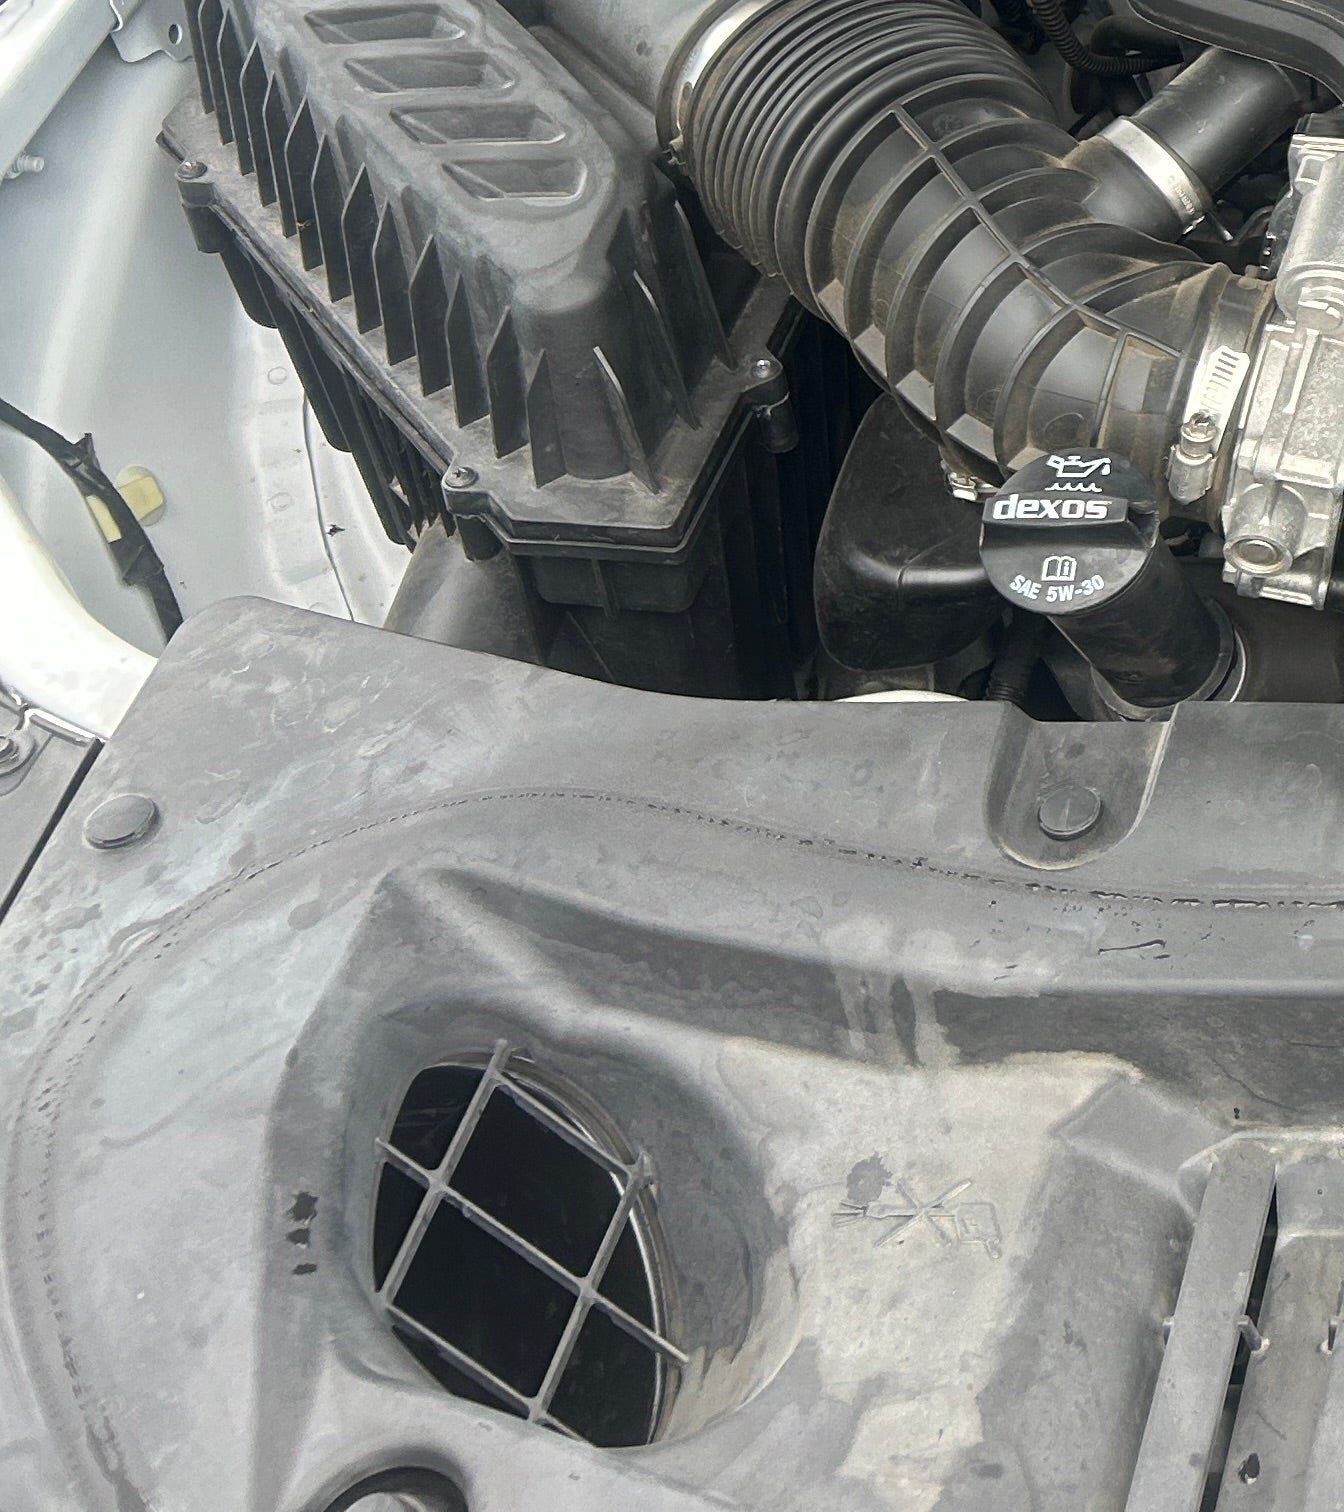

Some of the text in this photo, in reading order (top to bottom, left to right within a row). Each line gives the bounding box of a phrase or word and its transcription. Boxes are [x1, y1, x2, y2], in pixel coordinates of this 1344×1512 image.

[992, 493, 1111, 520] dexos
[1009, 574, 1105, 603] SAE 5W-30
